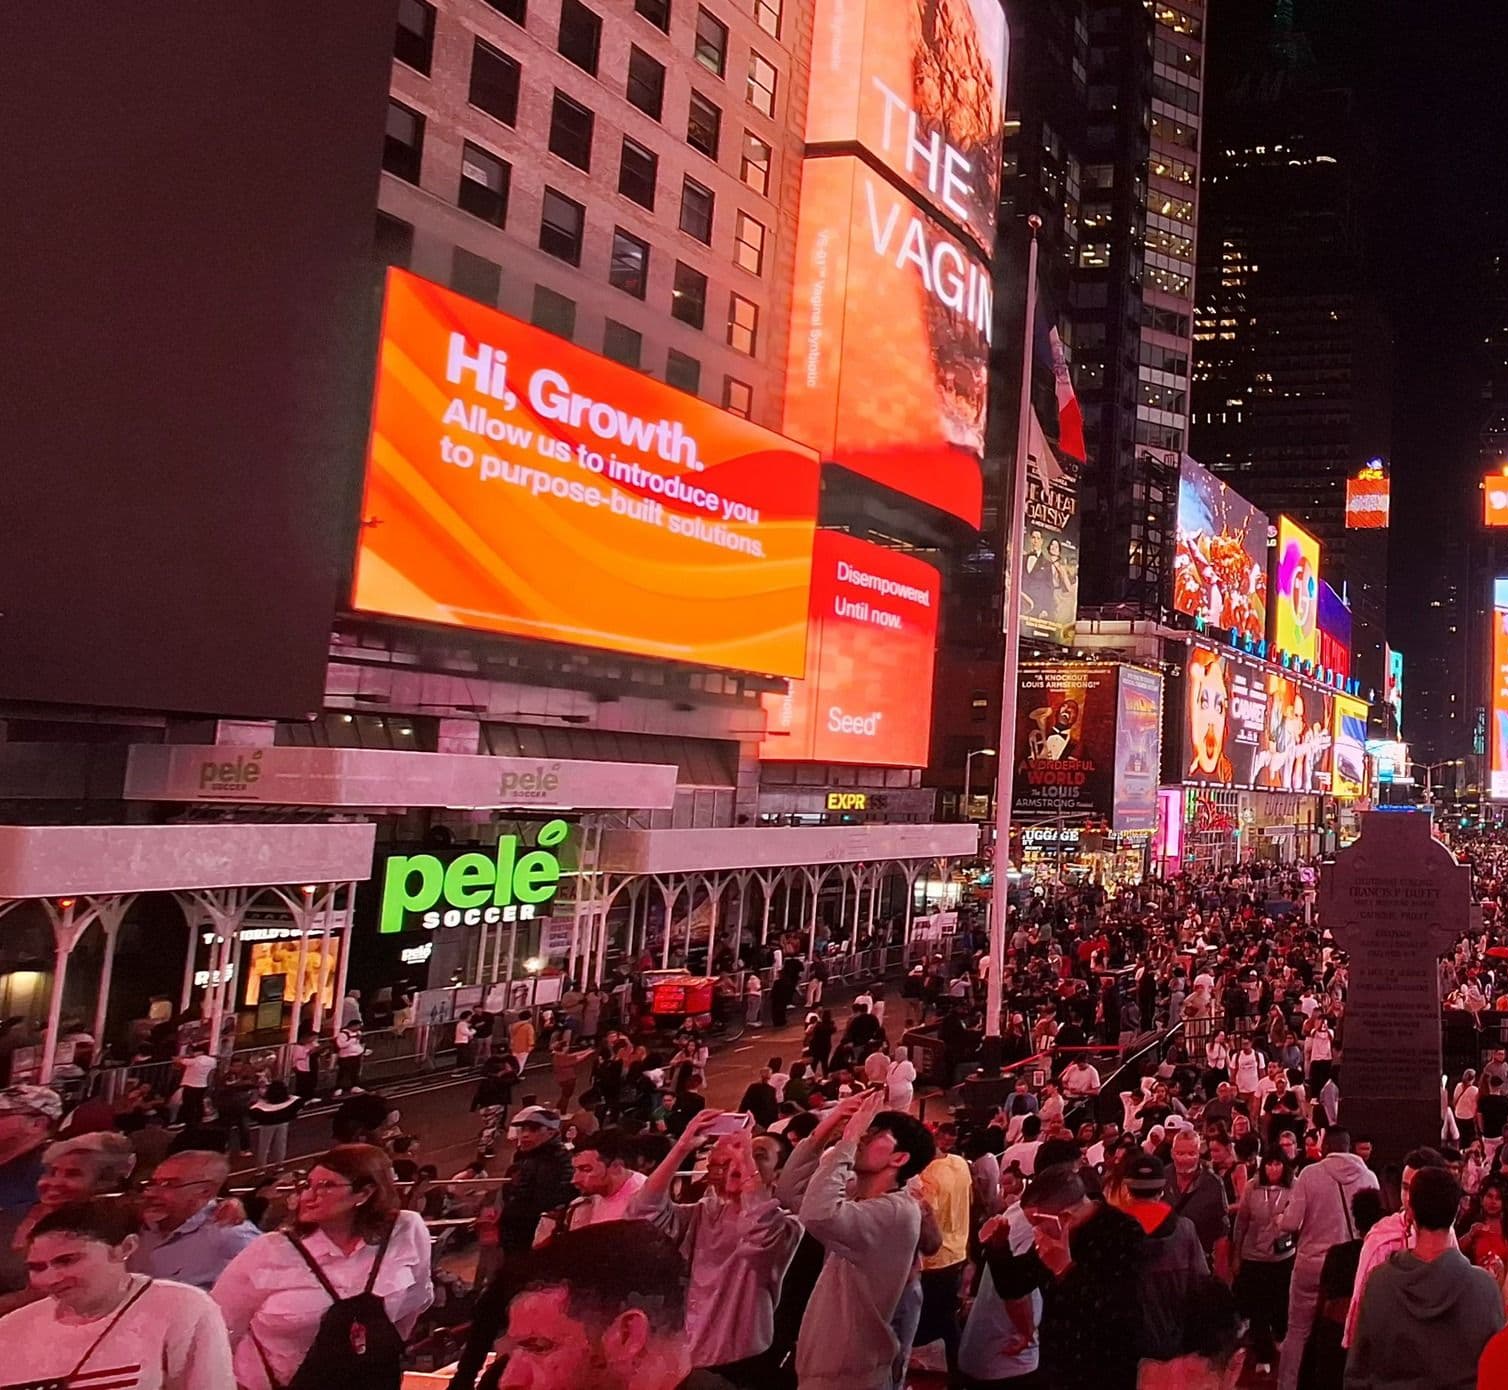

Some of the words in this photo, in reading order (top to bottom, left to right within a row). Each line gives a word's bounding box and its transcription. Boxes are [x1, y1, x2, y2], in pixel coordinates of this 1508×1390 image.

[871, 76, 971, 220] THE
[866, 179, 993, 348] VAGIN
[446, 331, 517, 411] Hi,
[528, 368, 705, 471] Growth.
[440, 435, 474, 468] to
[480, 455, 664, 526] purpose-built
[668, 514, 766, 558] solutions.
[442, 398, 533, 448] Allow
[537, 434, 571, 463] us
[576, 443, 603, 473] to
[608, 453, 719, 511] introduce
[721, 498, 759, 525] you
[835, 595, 868, 622] Until
[871, 612, 902, 629] now.
[1016, 798, 1075, 808] ARMSTRONG
[1028, 771, 1085, 785] WORLD
[1042, 786, 1080, 797] LOUIS
[1022, 830, 1078, 842] UGGAGE
[380, 819, 568, 933] pelé
[422, 904, 536, 929] SOCCER
